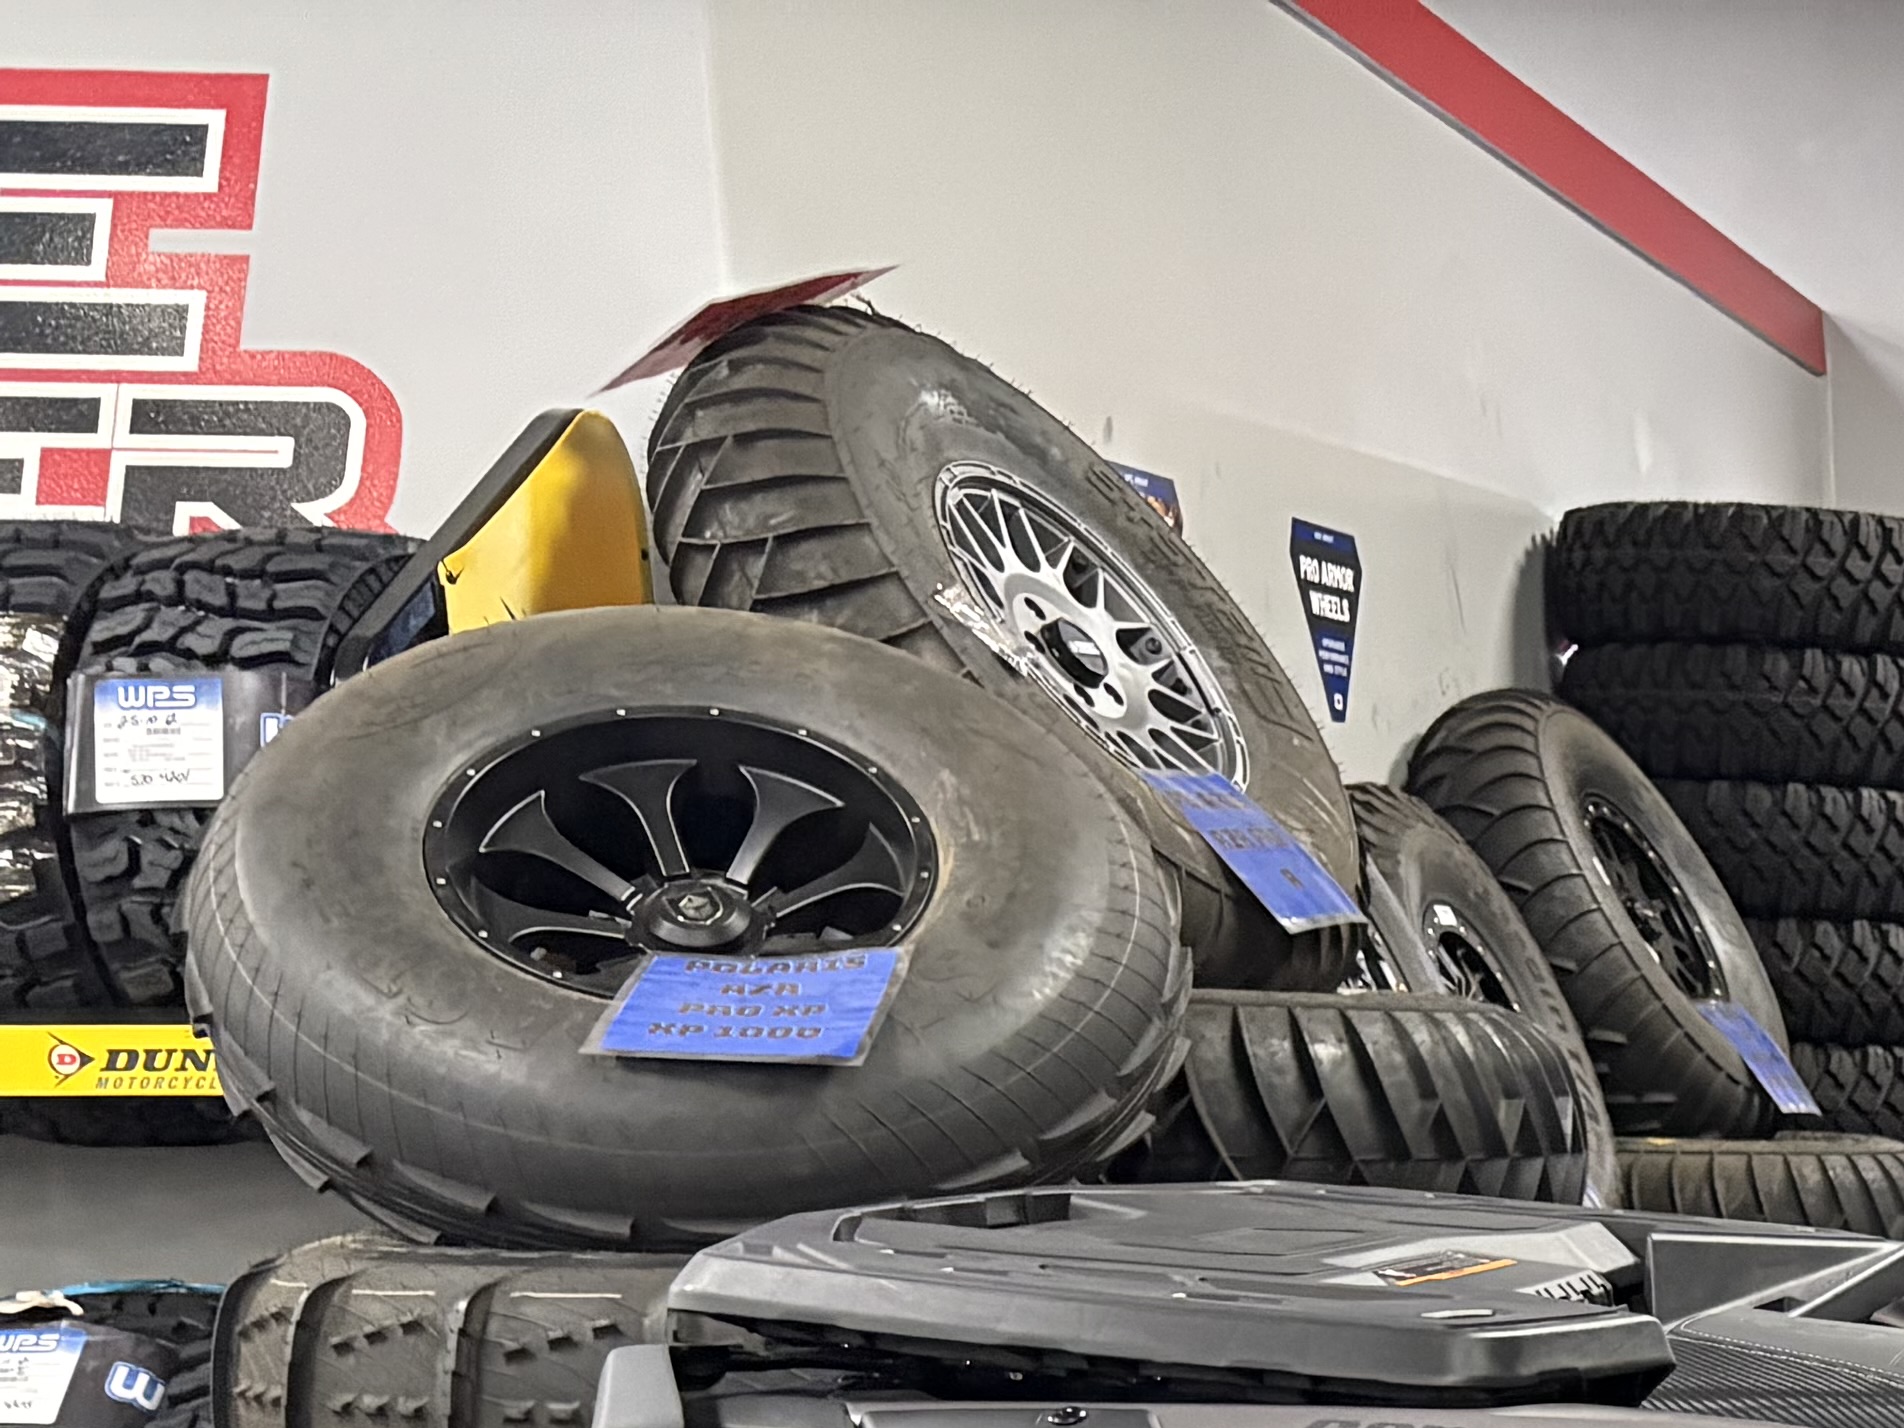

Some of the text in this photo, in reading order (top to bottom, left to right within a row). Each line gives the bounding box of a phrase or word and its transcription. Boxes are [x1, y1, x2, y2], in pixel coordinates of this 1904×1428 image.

[1299, 554, 1355, 593] PRO ARMOR
[1308, 589, 1351, 623] WHEELS
[117, 684, 197, 710] WPS
[684, 953, 867, 975] POLARIS
[677, 1003, 828, 1018] PRO XP
[647, 1022, 824, 1040] XP 1000
[99, 1048, 217, 1072] DUN
[95, 1075, 218, 1090] MOTORCYCL
